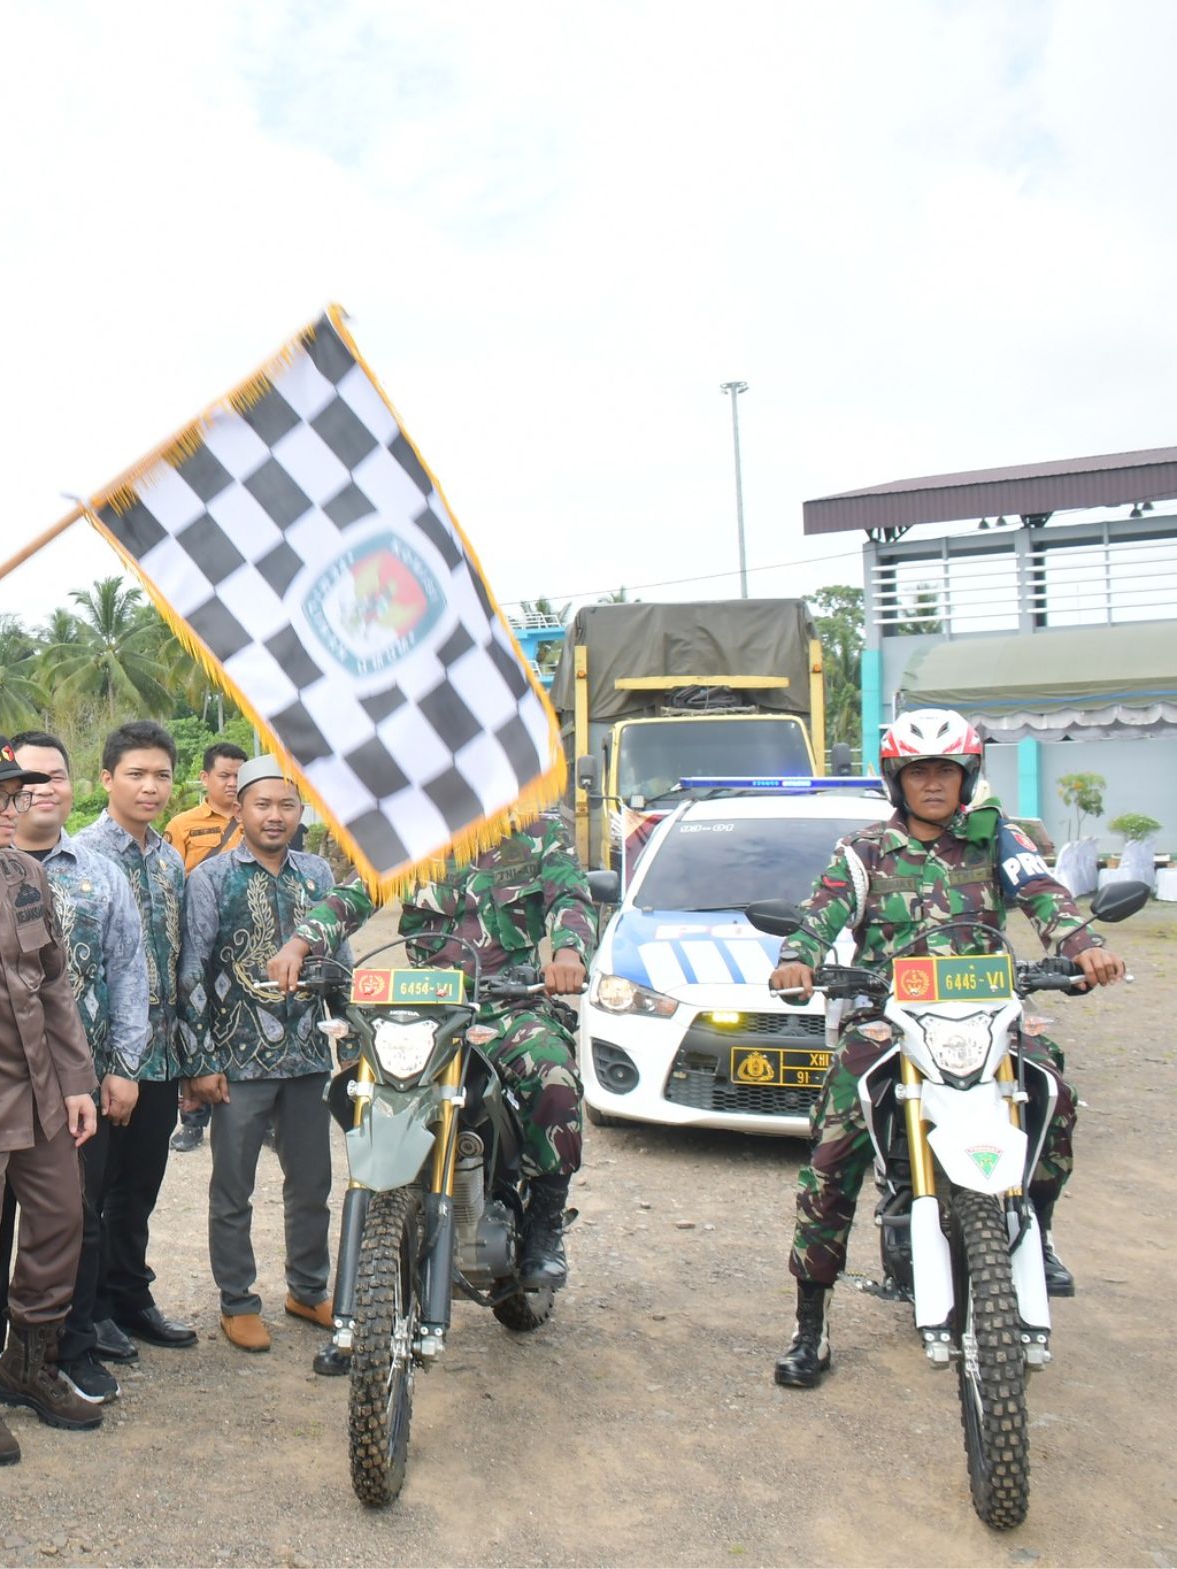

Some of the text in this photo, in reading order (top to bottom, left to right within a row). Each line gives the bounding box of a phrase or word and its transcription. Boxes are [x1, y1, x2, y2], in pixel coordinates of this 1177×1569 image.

[655, 924, 773, 939] PO
[946, 971, 1005, 990] 6445-VI
[400, 982, 453, 996] 6454-VI
